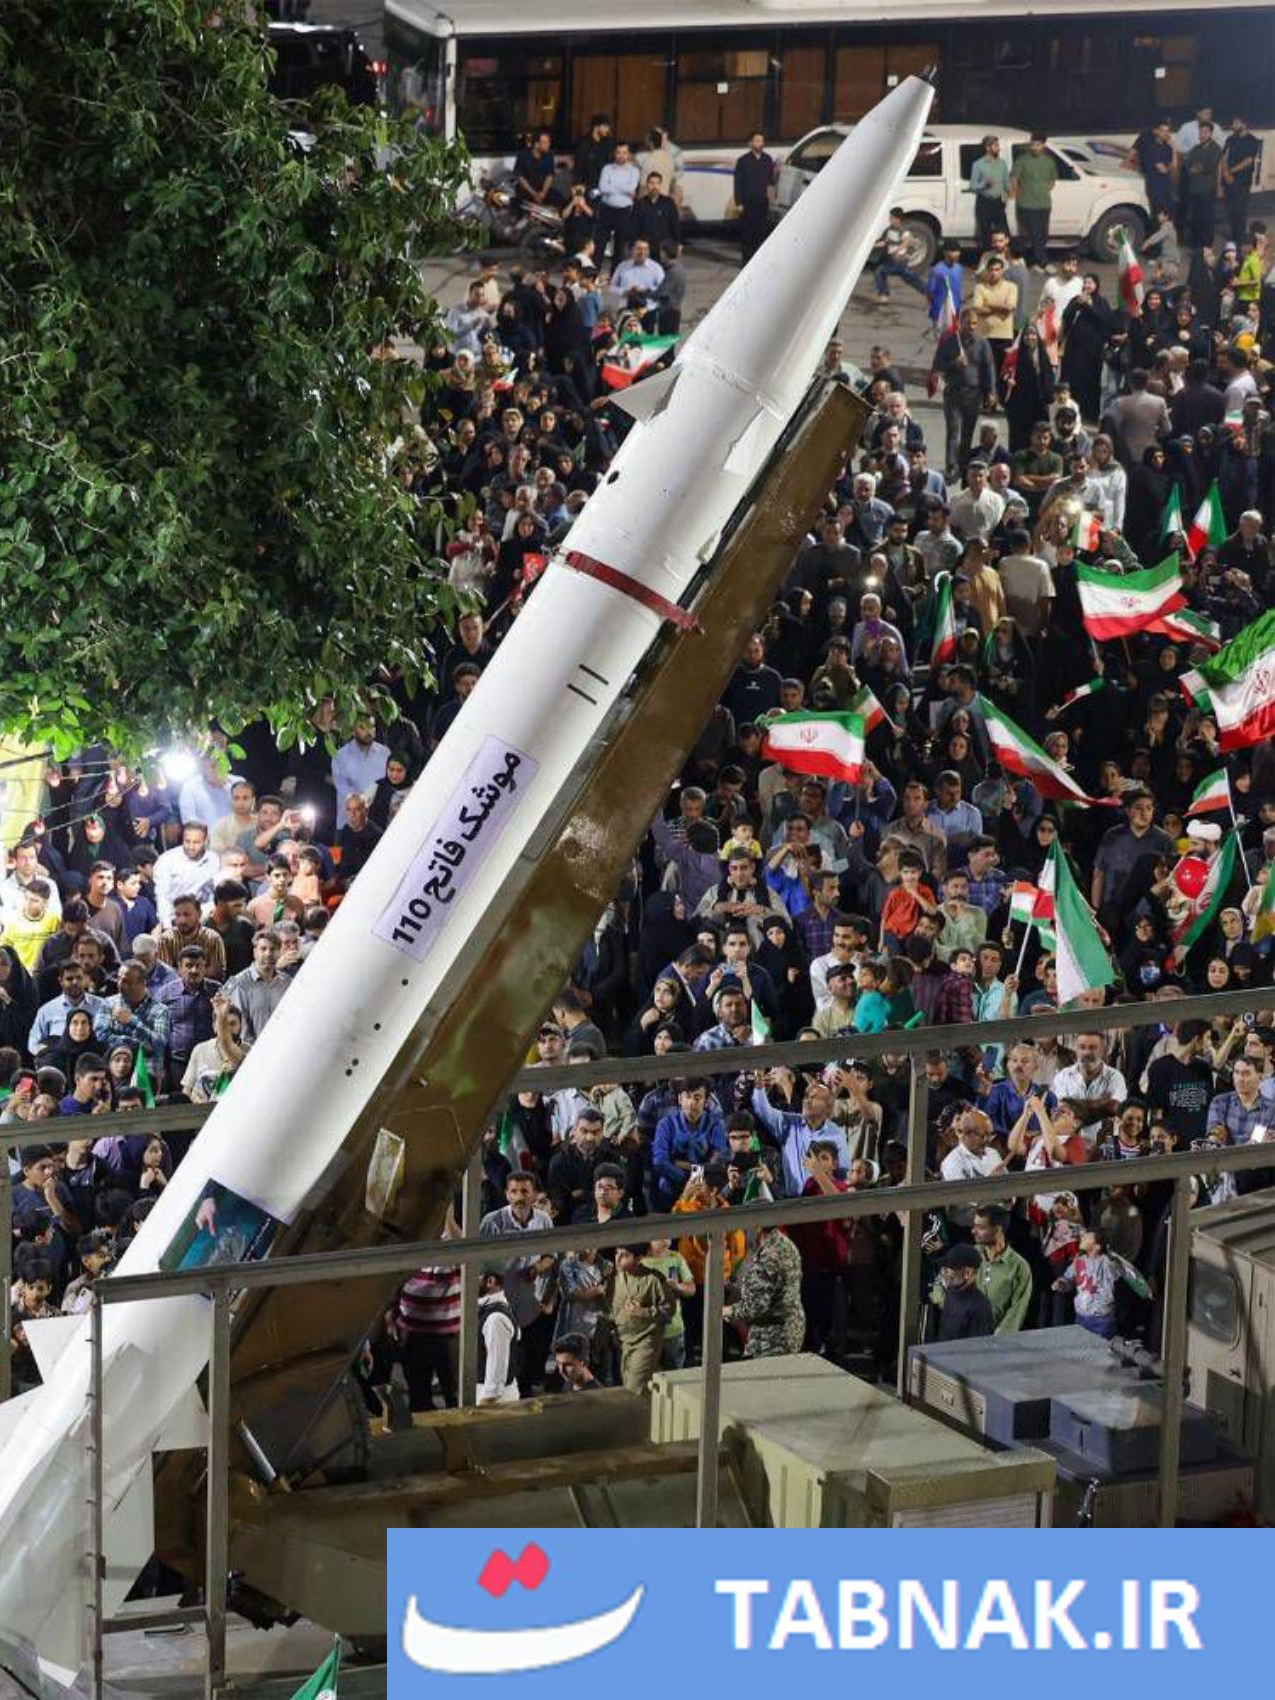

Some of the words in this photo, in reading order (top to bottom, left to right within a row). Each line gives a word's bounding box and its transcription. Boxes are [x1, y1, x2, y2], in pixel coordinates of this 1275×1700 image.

[458, 751, 522, 841] موشک
[423, 838, 466, 904] فاتح
[392, 898, 432, 945] 110
